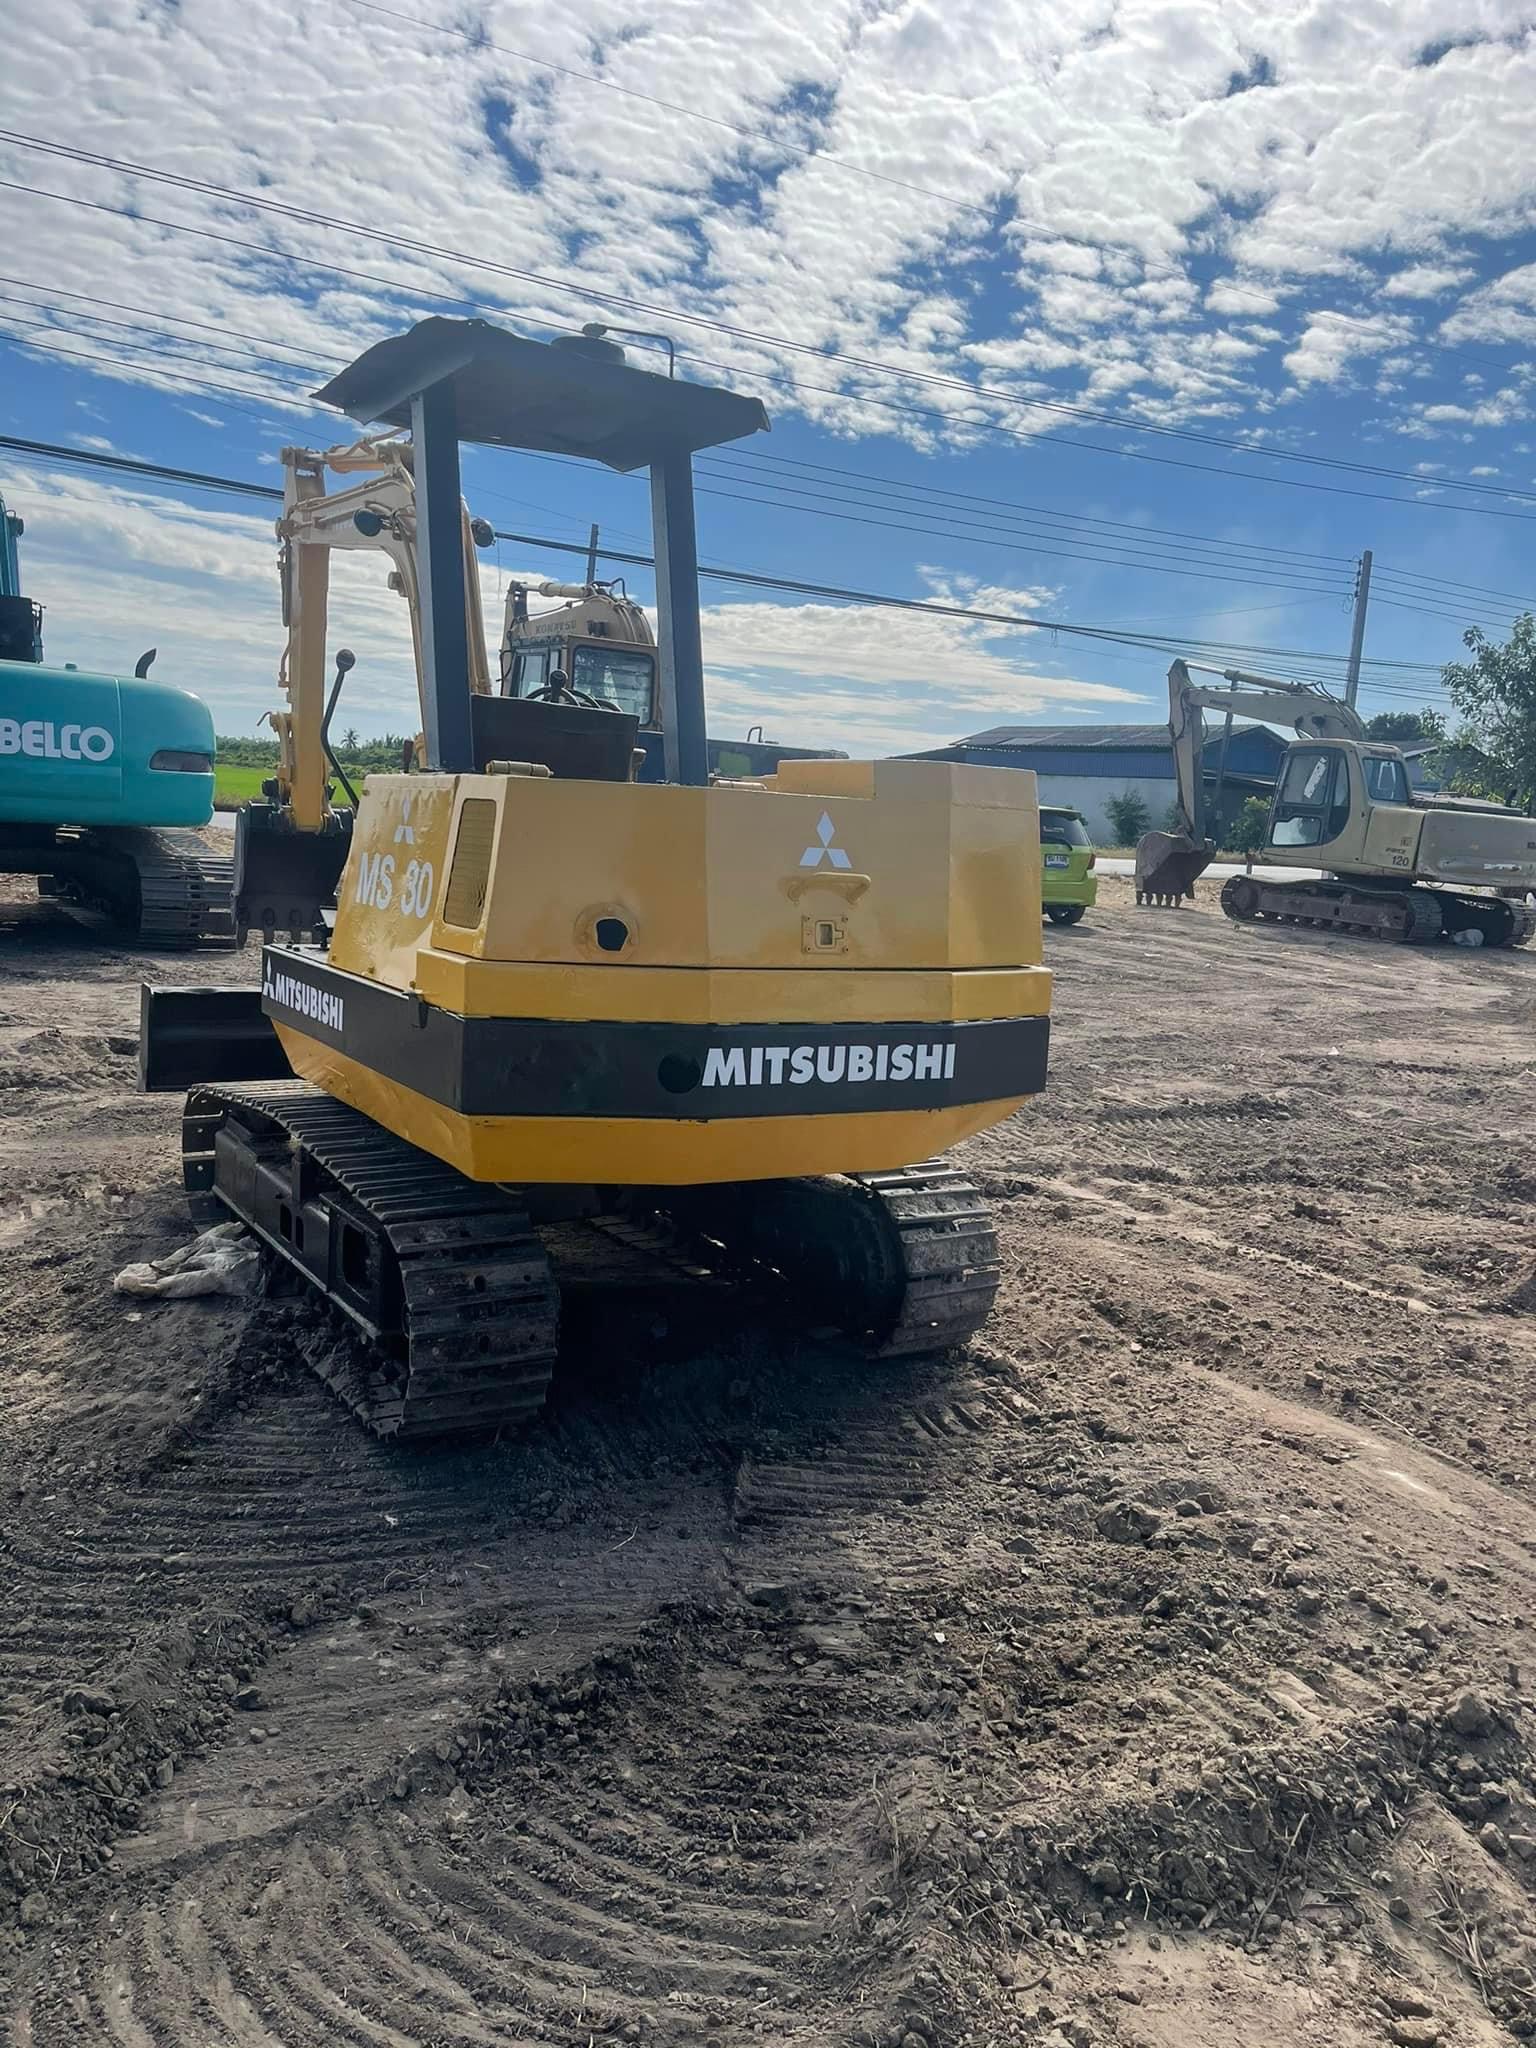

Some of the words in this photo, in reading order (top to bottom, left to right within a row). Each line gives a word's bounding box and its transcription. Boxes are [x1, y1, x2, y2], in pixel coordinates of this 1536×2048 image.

[355, 851, 396, 911] MS
[400, 859, 434, 919] 30
[1392, 855, 1410, 867] 120
[273, 972, 344, 1032] MITSUBISHI
[701, 1043, 956, 1088] MITSUBISHI
